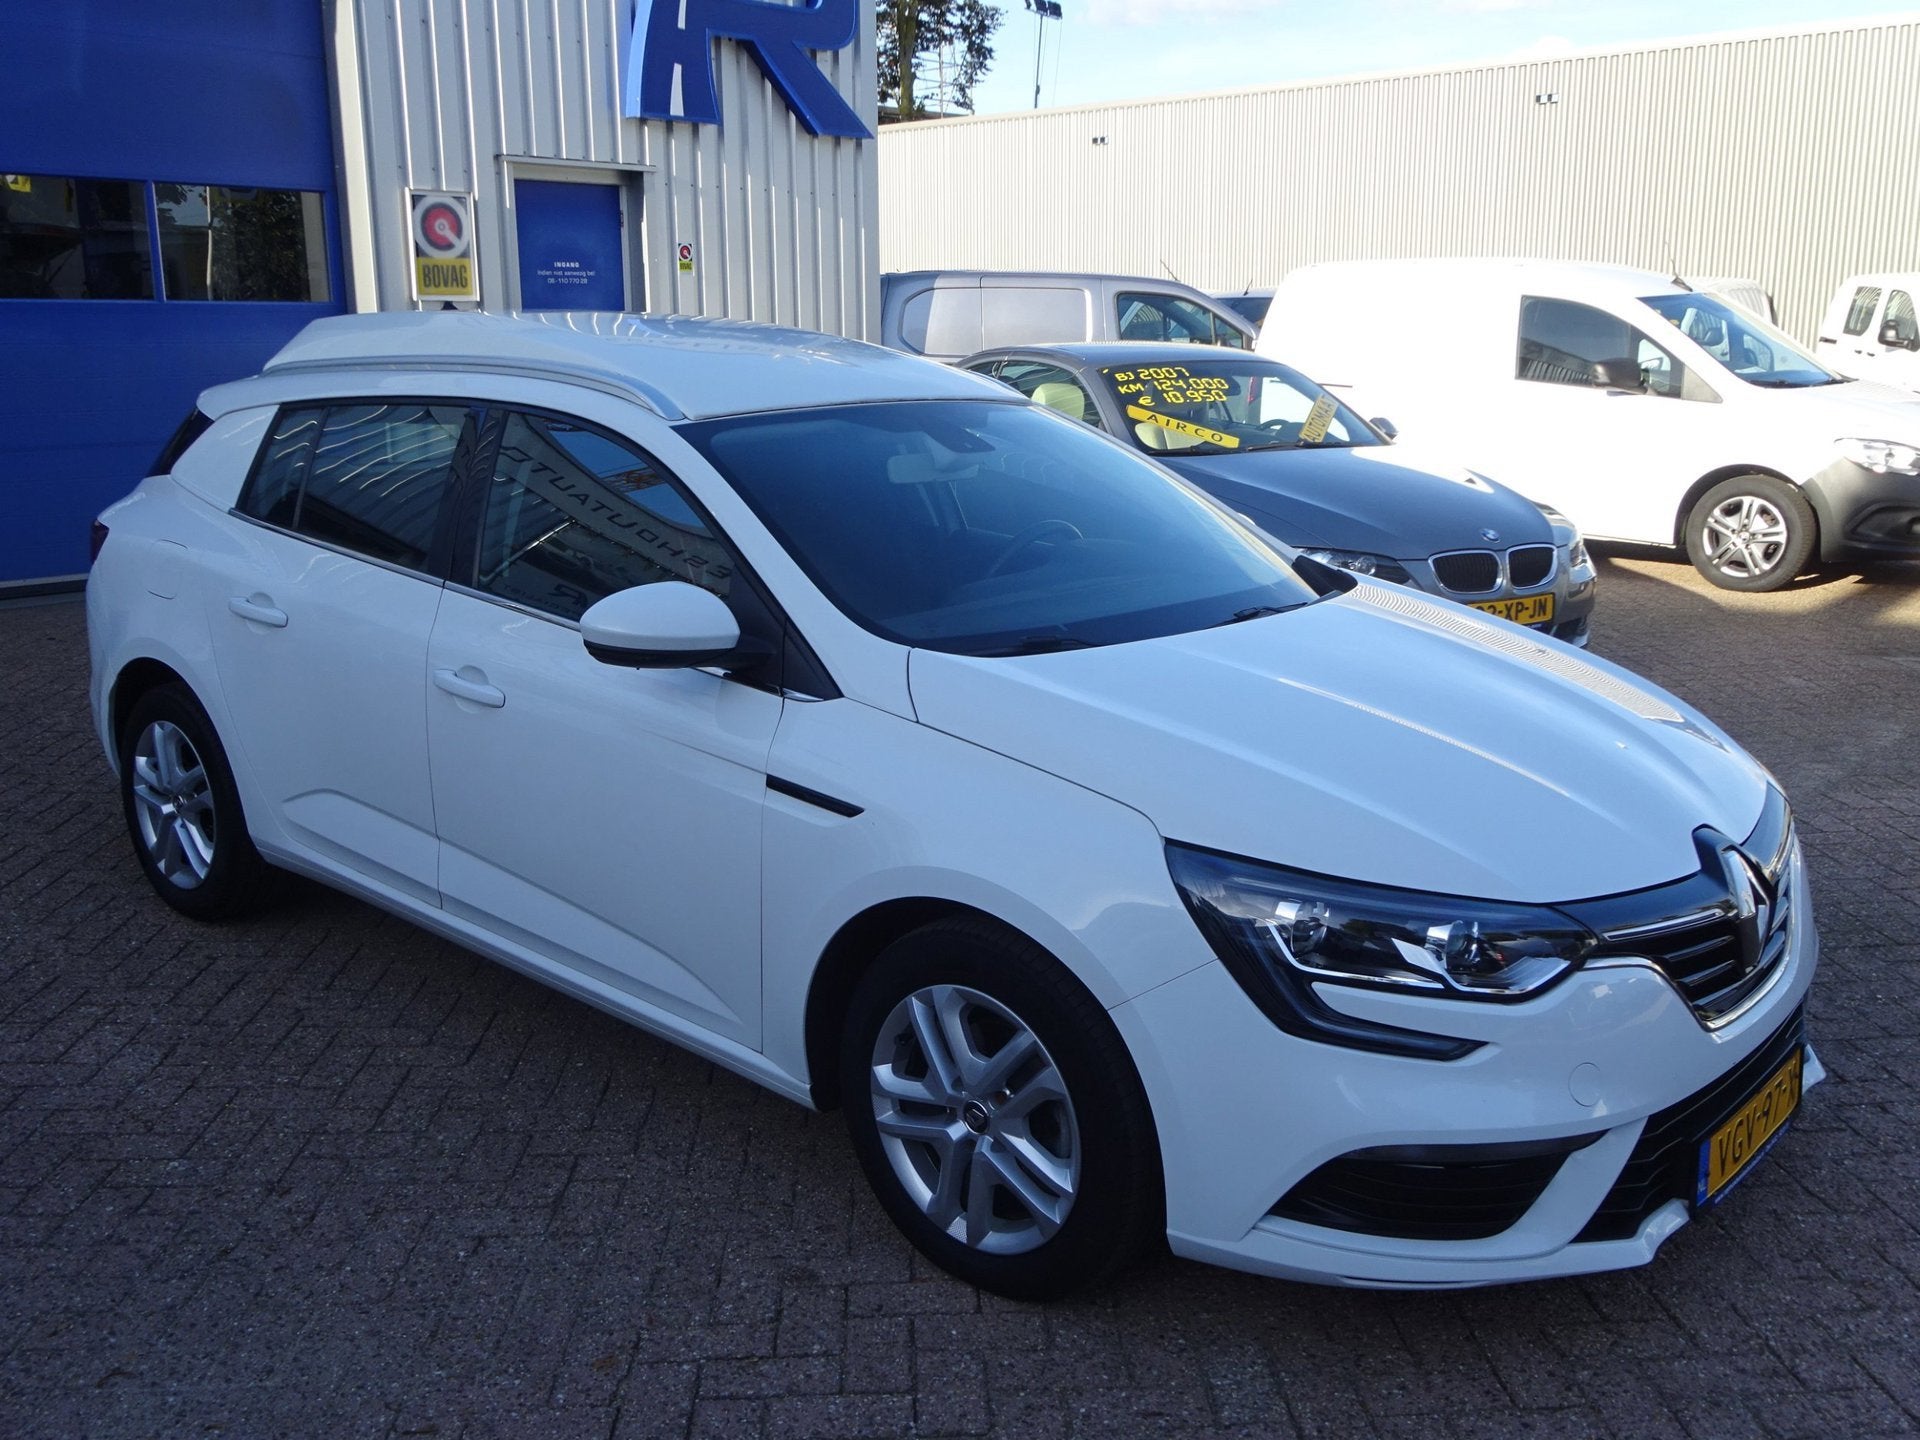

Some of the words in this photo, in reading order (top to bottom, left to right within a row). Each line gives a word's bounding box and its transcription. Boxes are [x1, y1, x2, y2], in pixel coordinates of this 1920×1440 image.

[422, 264, 468, 288] BOVAG
[1114, 371, 1135, 382] BJ
[1137, 367, 1190, 380] 2007
[1118, 382, 1145, 395] KM
[1163, 390, 1228, 404] 10.950
[1146, 413, 1223, 443] AIRCO
